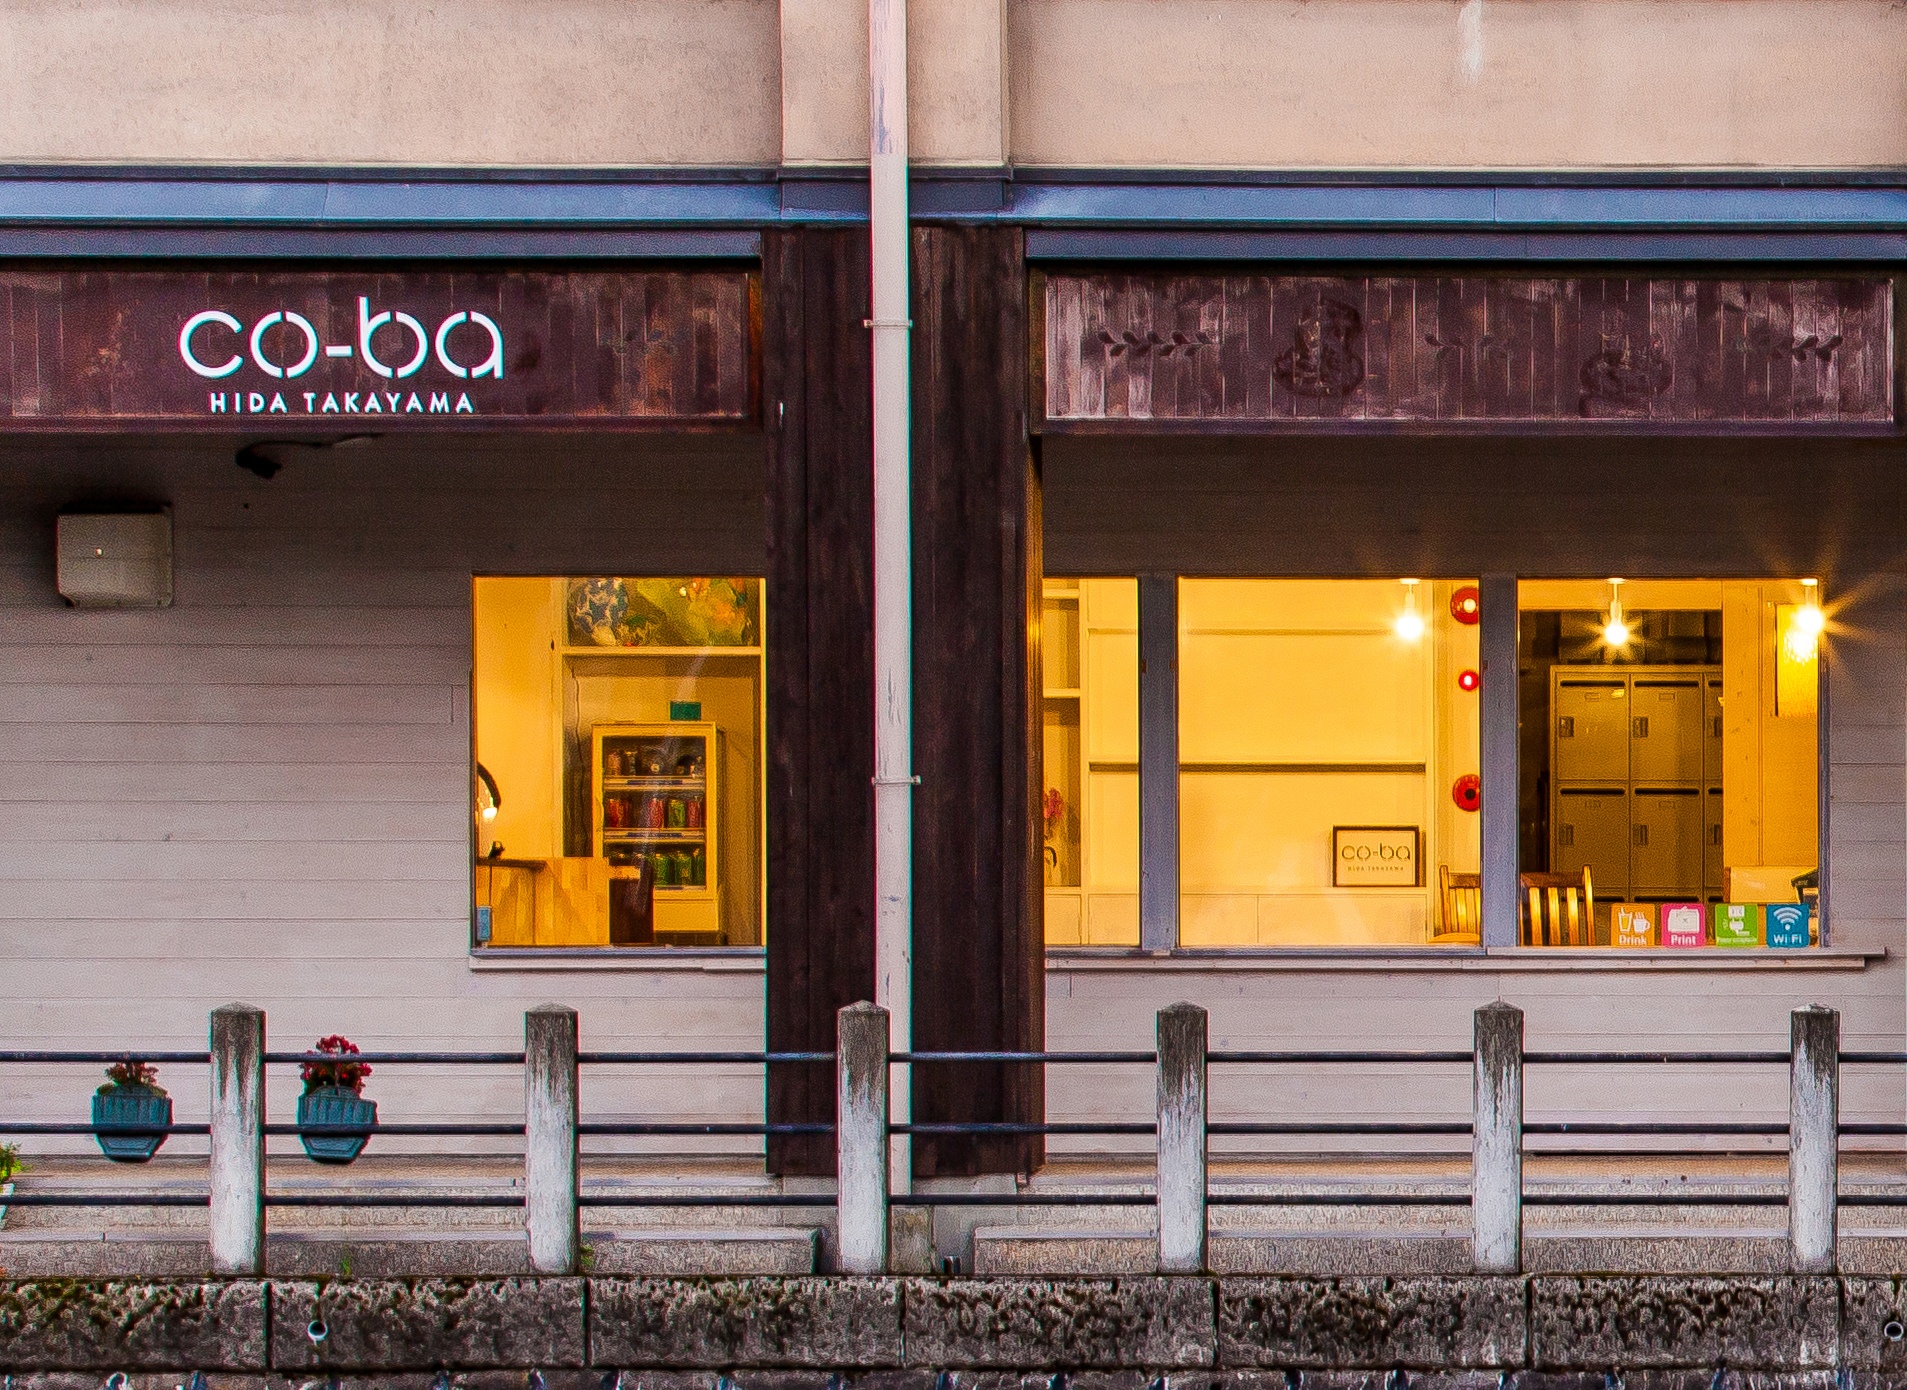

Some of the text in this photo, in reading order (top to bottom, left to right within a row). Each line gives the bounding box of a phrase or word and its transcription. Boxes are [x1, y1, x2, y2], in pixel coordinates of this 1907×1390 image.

[178, 296, 504, 379] co-ba
[209, 392, 474, 413] HIDA TAKAYAMA
[1341, 842, 1411, 860] co-ba
[1618, 934, 1647, 945] Drink
[1670, 934, 1697, 945] Print
